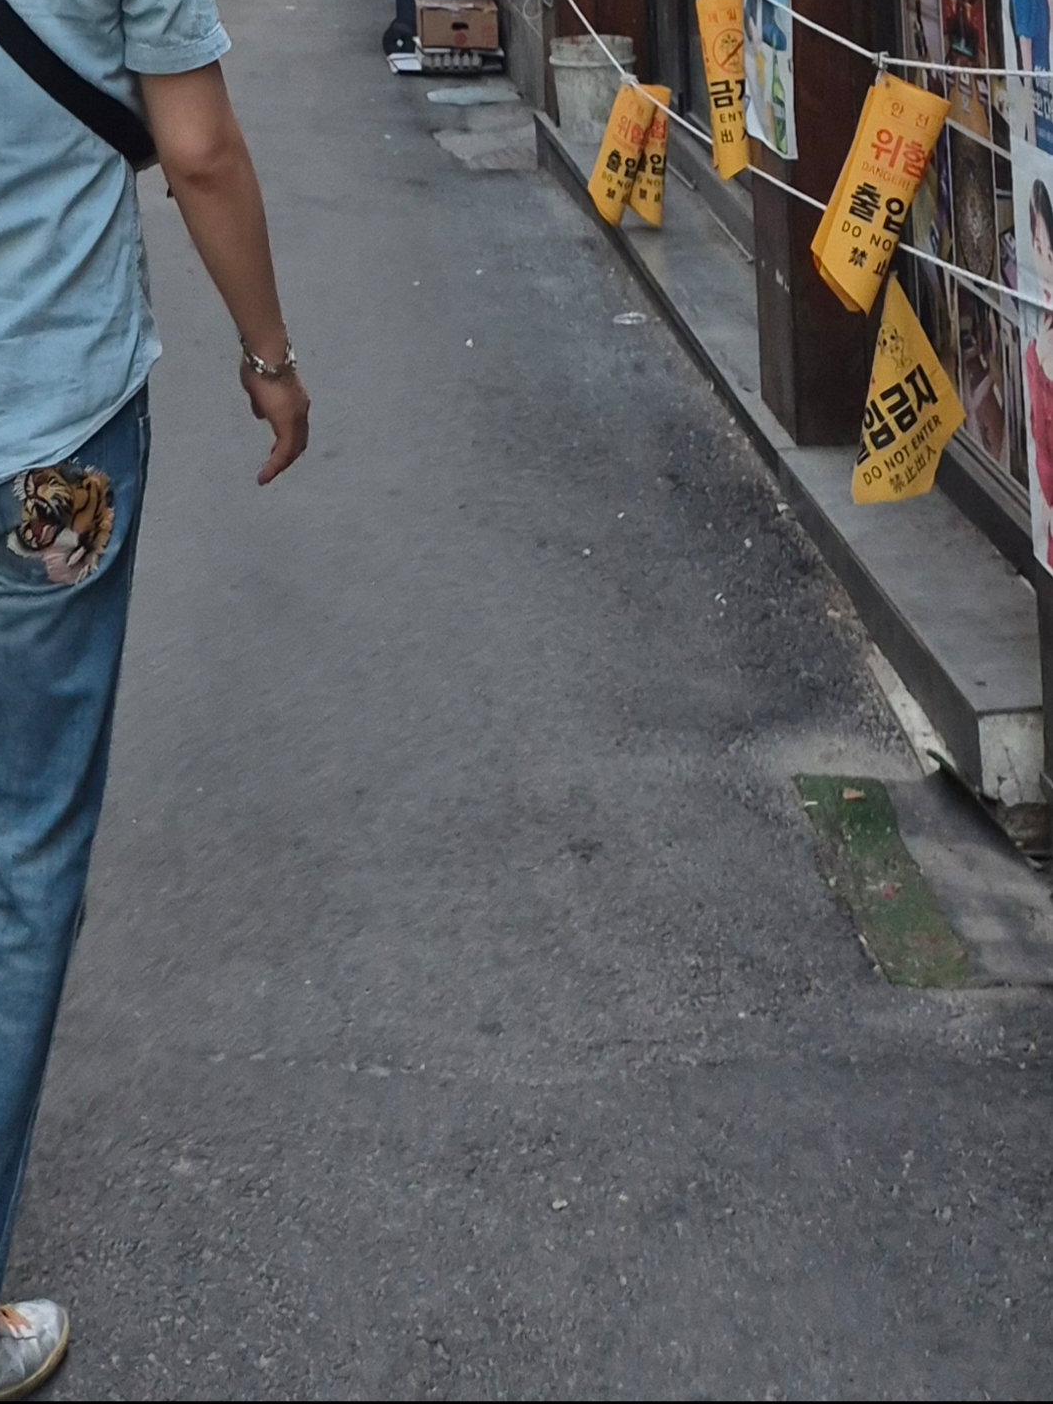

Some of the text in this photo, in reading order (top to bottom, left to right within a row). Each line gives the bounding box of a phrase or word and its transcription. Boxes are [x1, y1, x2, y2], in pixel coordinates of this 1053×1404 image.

[841, 220, 863, 238] DO
[862, 413, 943, 487] DO NOT ENTER
